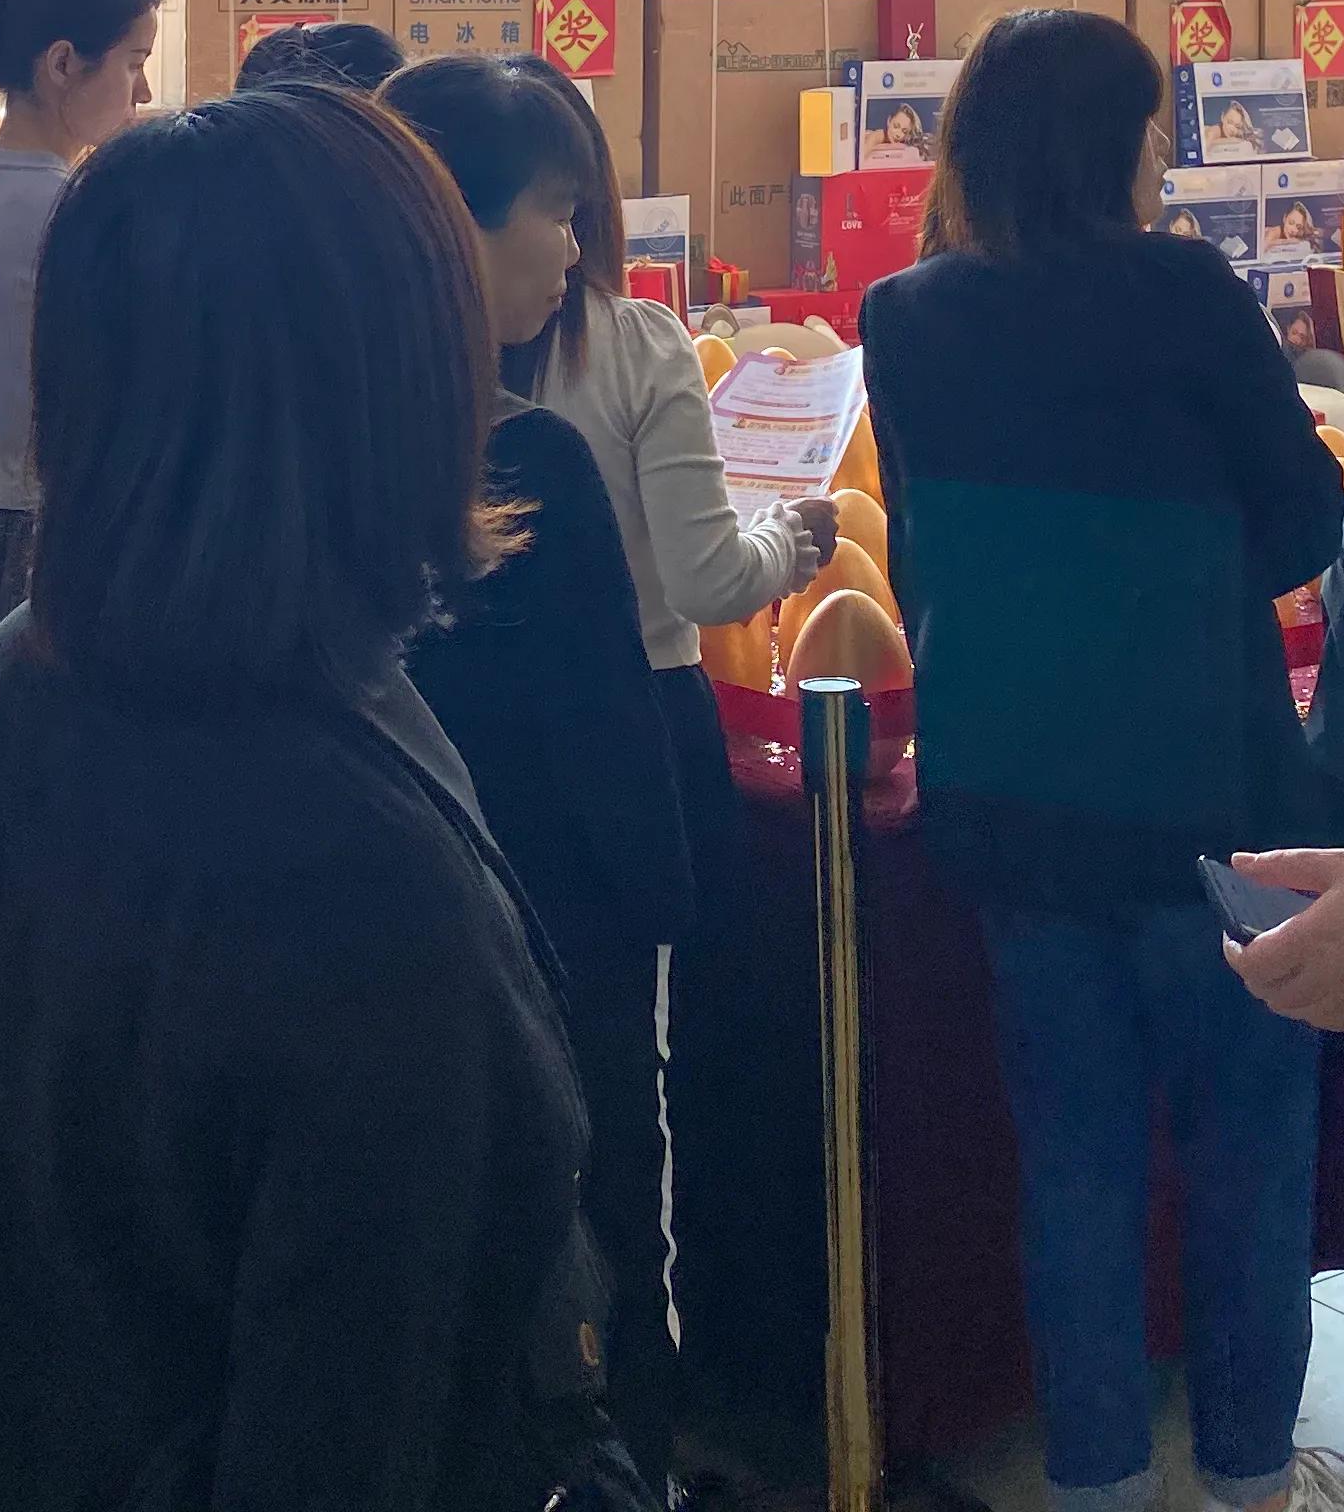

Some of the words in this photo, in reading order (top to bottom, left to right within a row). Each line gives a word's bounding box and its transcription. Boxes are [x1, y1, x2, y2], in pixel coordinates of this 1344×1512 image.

[410, 20, 521, 44] 电冰箱
[554, 9, 598, 52] 奖
[1189, 21, 1217, 58] 奖
[1308, 20, 1337, 57] 奖
[729, 184, 794, 206] 此面产
